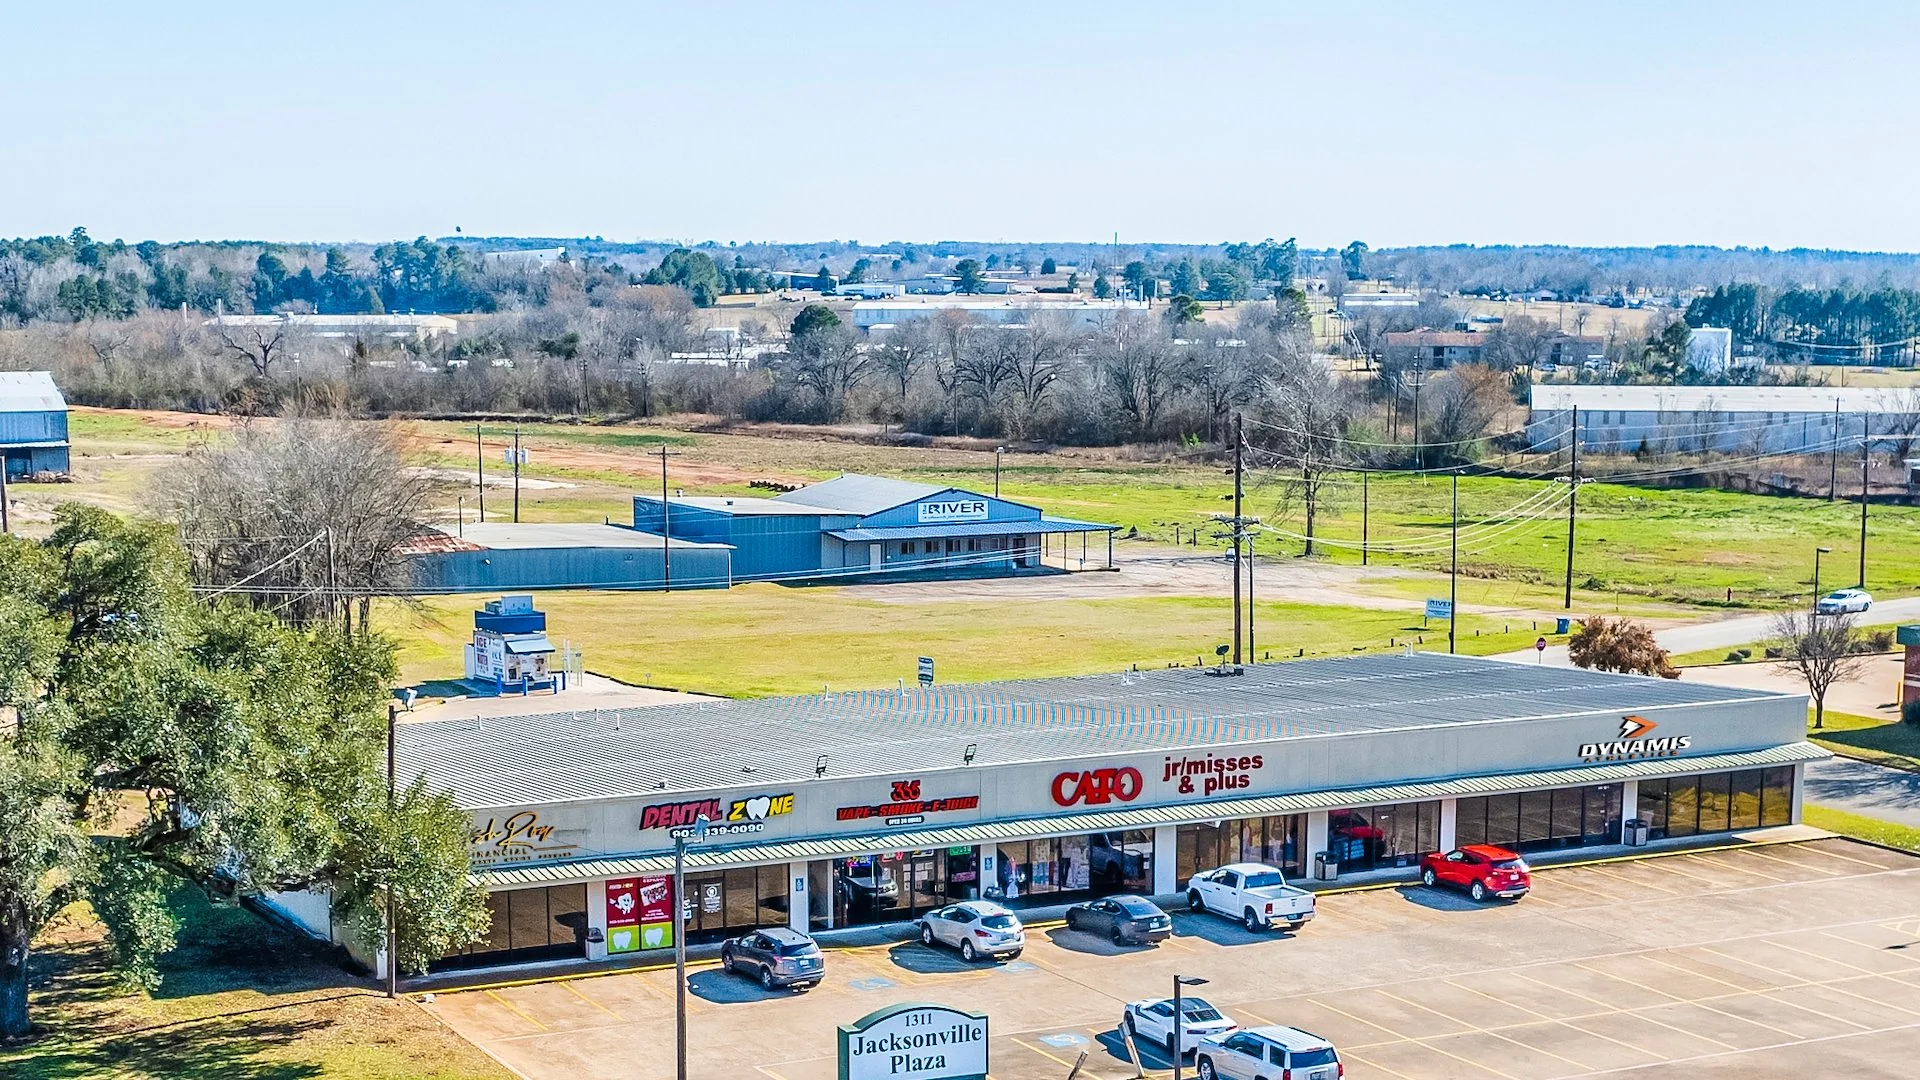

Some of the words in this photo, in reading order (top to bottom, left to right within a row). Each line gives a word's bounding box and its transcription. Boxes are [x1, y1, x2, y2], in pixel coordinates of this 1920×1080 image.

[928, 503, 985, 514] RIVER
[476, 637, 487, 648] ICE
[1578, 736, 1692, 757] DYNAMIS
[1163, 753, 1263, 782] jr/misses
[1051, 766, 1143, 806] CATO
[1178, 776, 1195, 794] &
[1204, 771, 1250, 796] plus
[640, 798, 722, 830] DENTAL
[471, 847, 527, 860] INANCIAL
[905, 1013, 932, 1027] 1311
[853, 1024, 982, 1056] Jacksonville
[890, 1054, 946, 1074] Plaza
